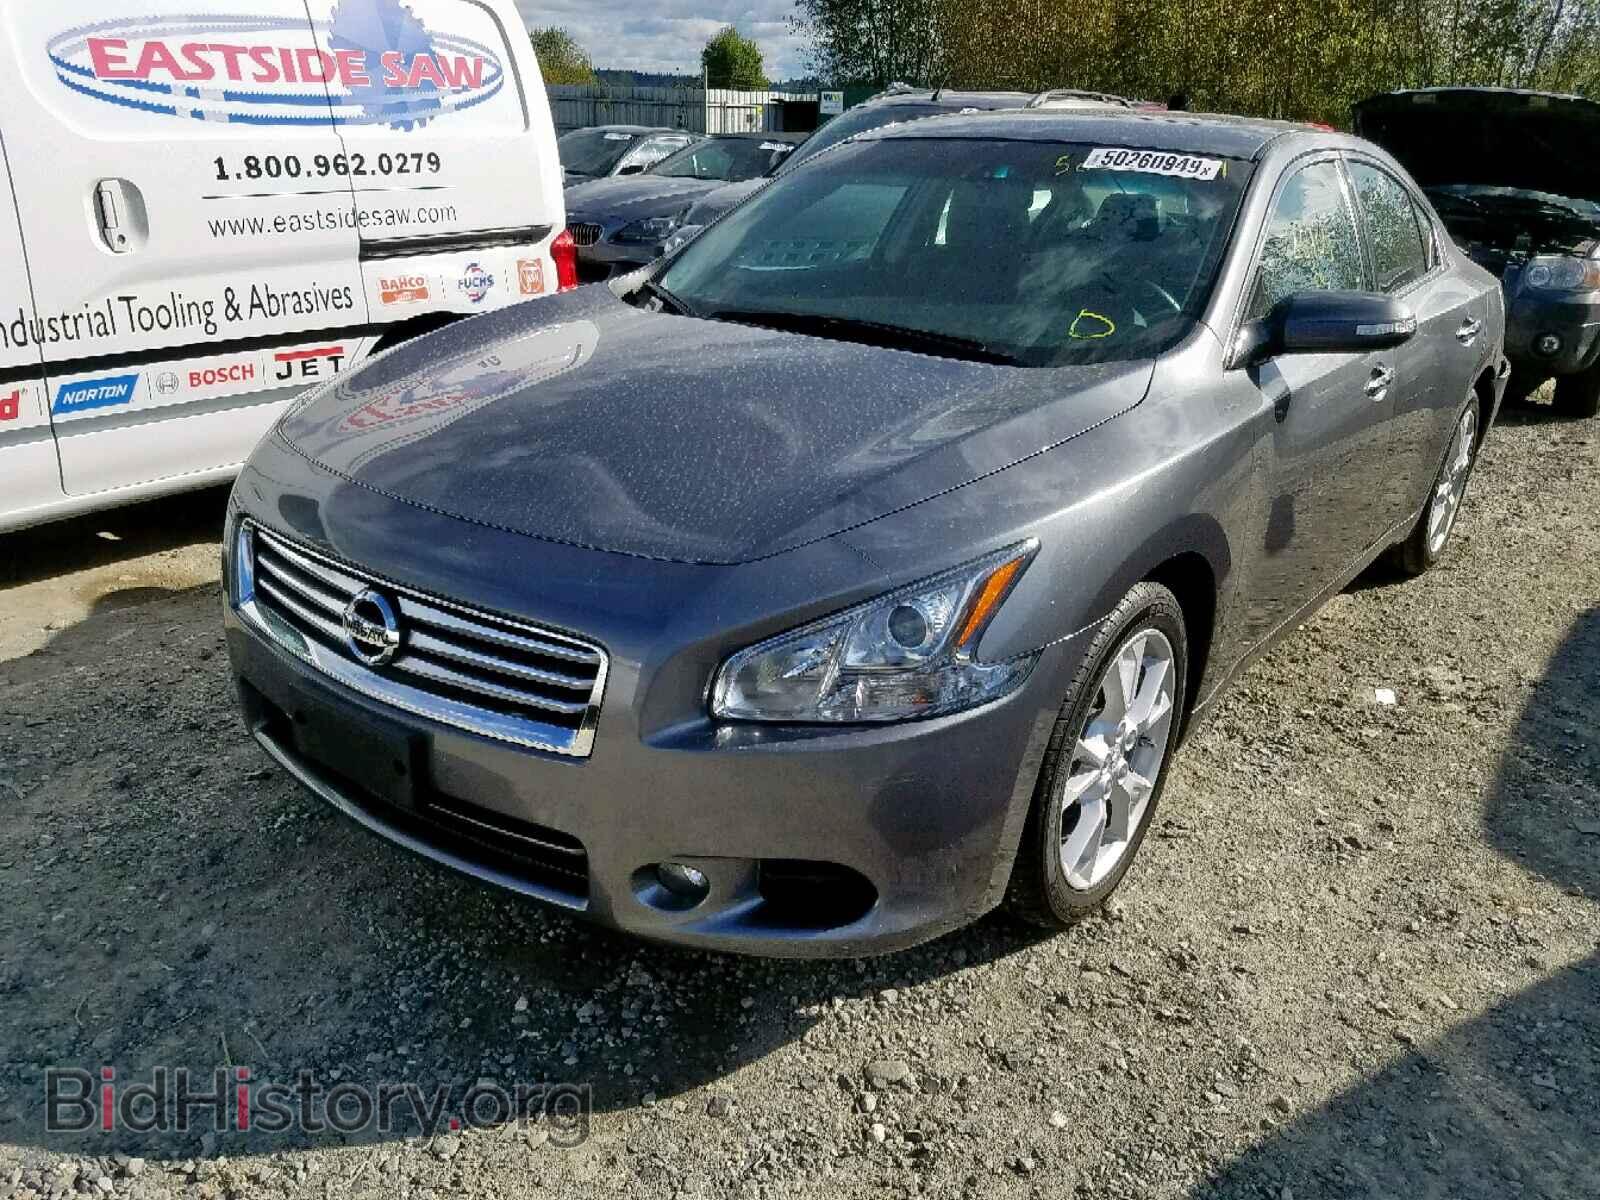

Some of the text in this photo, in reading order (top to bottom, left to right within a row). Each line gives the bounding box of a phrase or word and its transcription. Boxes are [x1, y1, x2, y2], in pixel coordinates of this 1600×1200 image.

[87, 38, 484, 89] EASTSIDE SAW
[213, 151, 441, 181] 1.800.962.0279
[207, 205, 457, 238] www.eastsidesaw.com
[380, 276, 425, 290] BAHCO
[458, 274, 495, 289] FUCHS
[118, 291, 217, 335] Tooling
[224, 286, 243, 321] &
[249, 281, 354, 319] Abrasives
[188, 364, 255, 388] BOSCH
[275, 355, 345, 381] JET
[62, 383, 128, 406] NORTON
